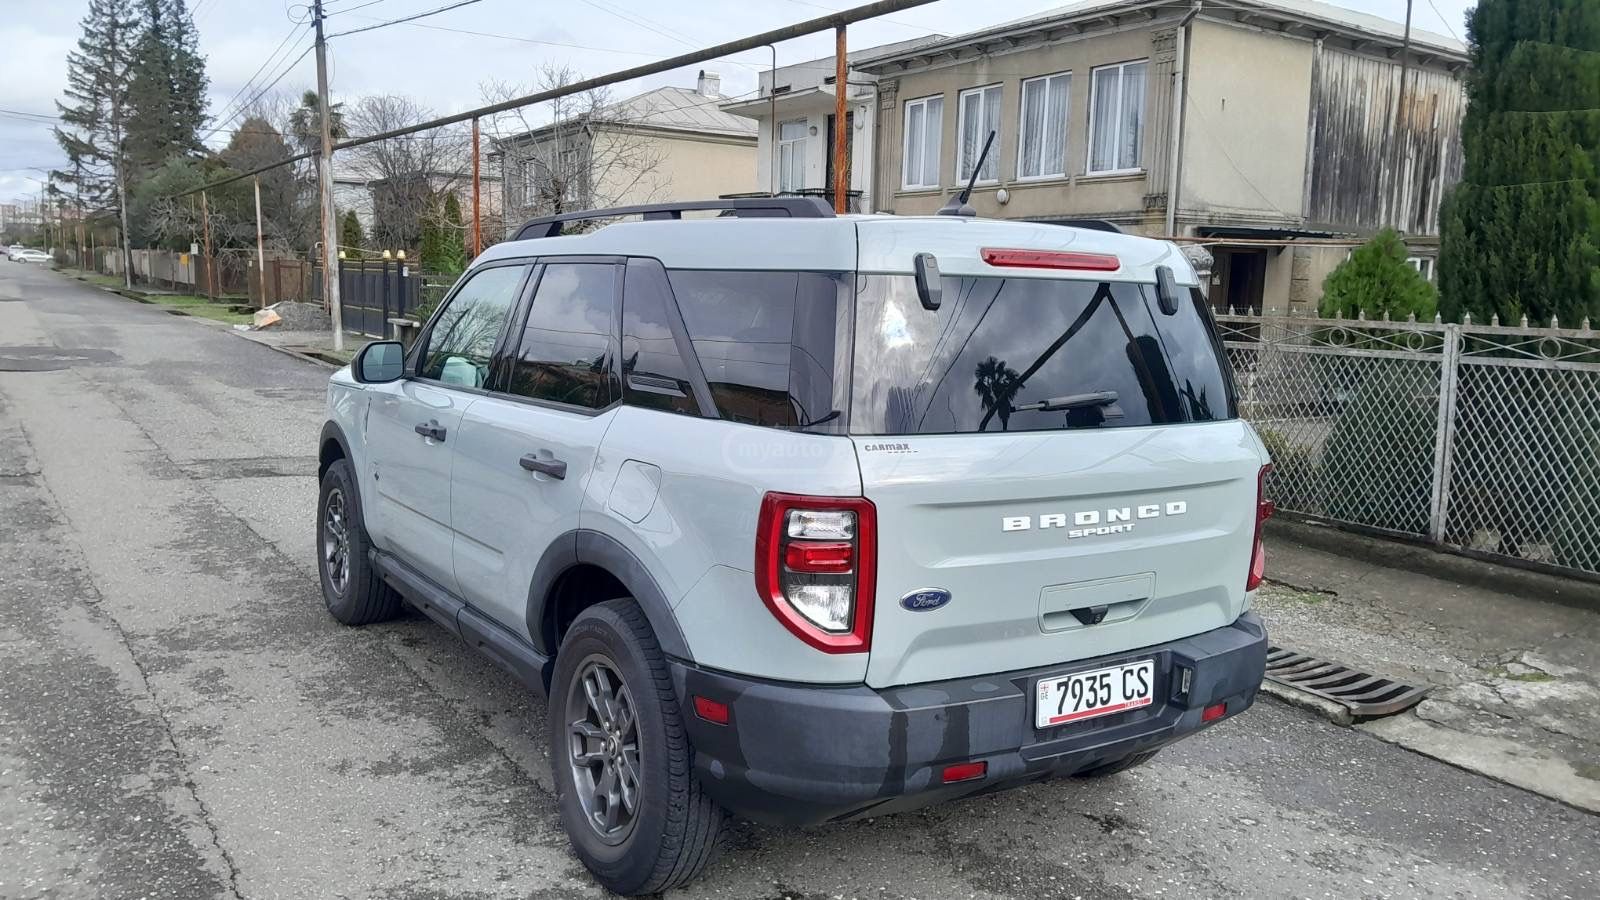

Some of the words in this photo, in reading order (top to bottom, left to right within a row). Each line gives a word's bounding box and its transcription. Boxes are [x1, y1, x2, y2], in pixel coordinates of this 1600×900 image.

[1002, 501, 1187, 532] BRONCO
[1067, 523, 1136, 539] SPORT
[912, 593, 941, 607] Ford
[1056, 673, 1112, 715] 7935
[1122, 666, 1149, 701] CS
